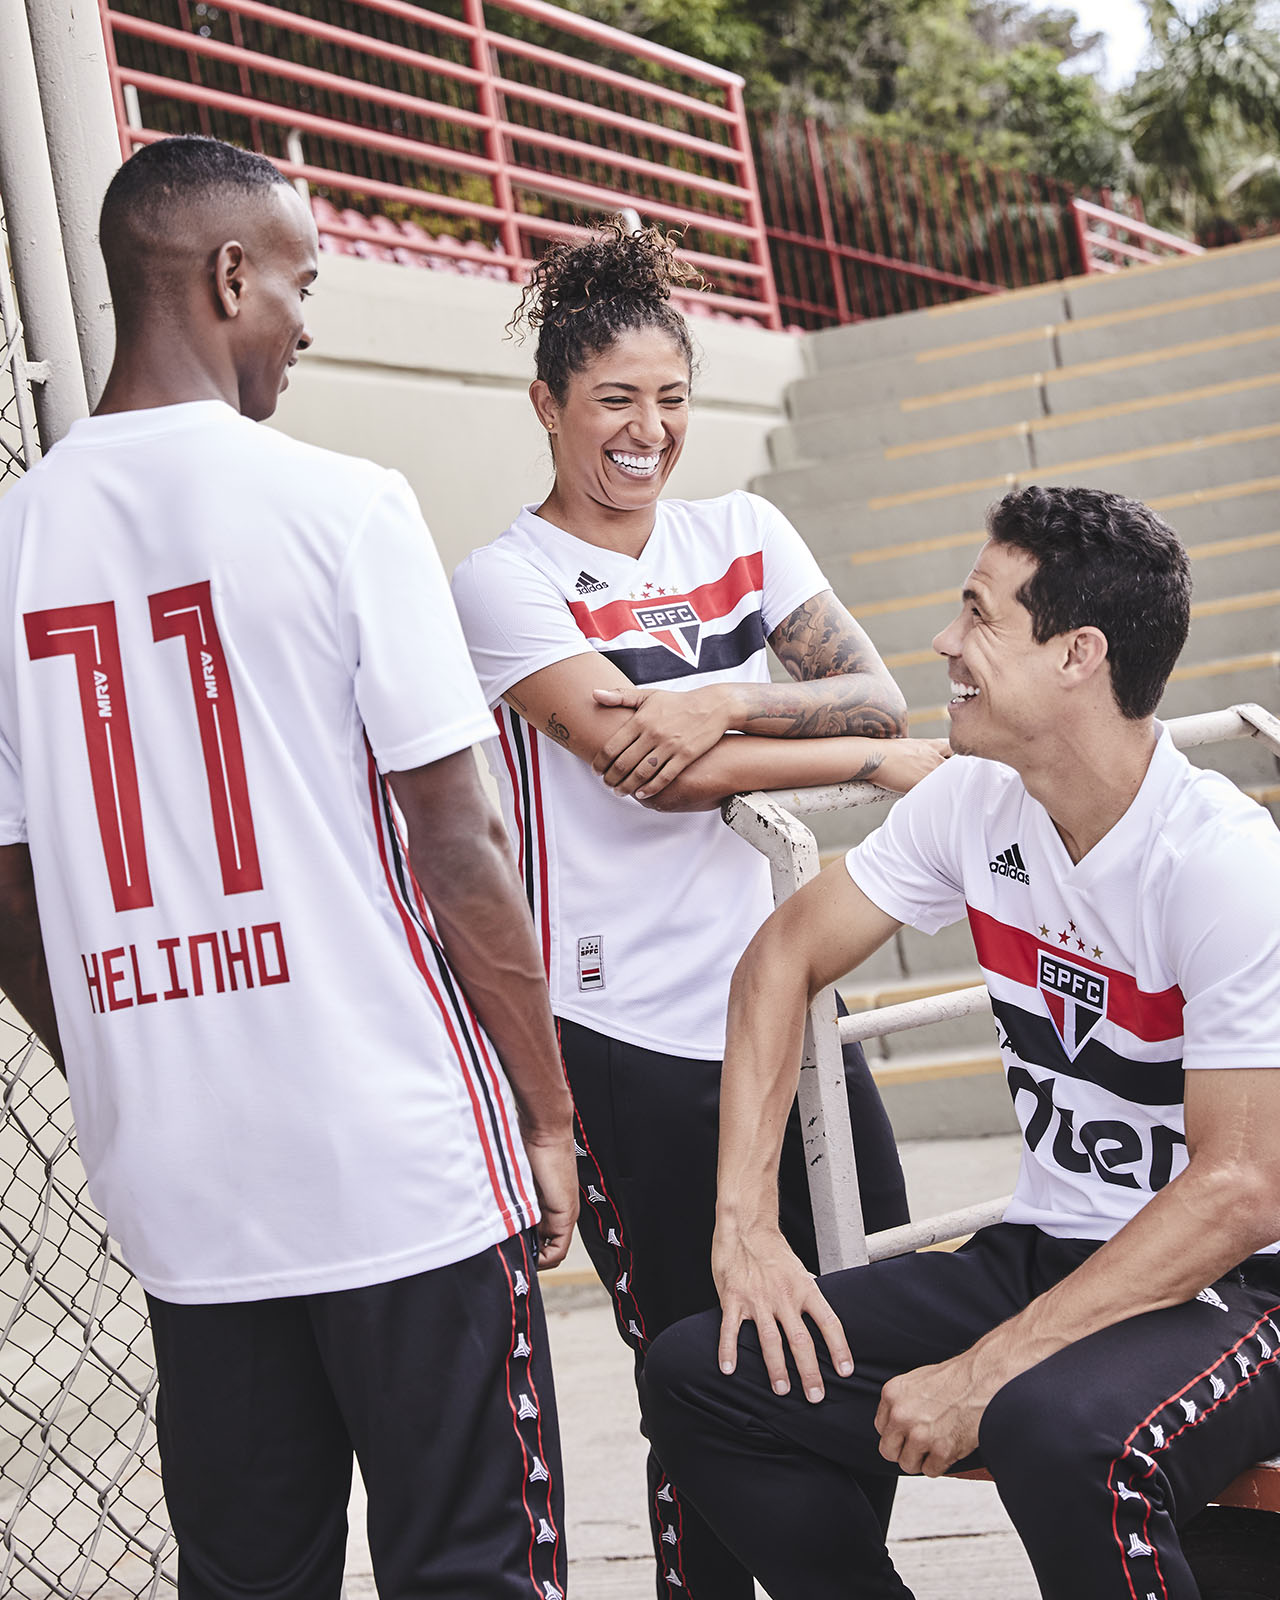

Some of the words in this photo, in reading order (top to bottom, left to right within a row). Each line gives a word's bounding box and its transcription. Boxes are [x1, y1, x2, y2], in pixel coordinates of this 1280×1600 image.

[641, 608, 692, 627] SPFC
[93, 670, 112, 718] MRV
[200, 651, 218, 698] MRV
[23, 580, 264, 913] 11
[989, 861, 1030, 885] adidas
[81, 922, 290, 1014] HELINHO
[1043, 961, 1100, 1003] SPFC
